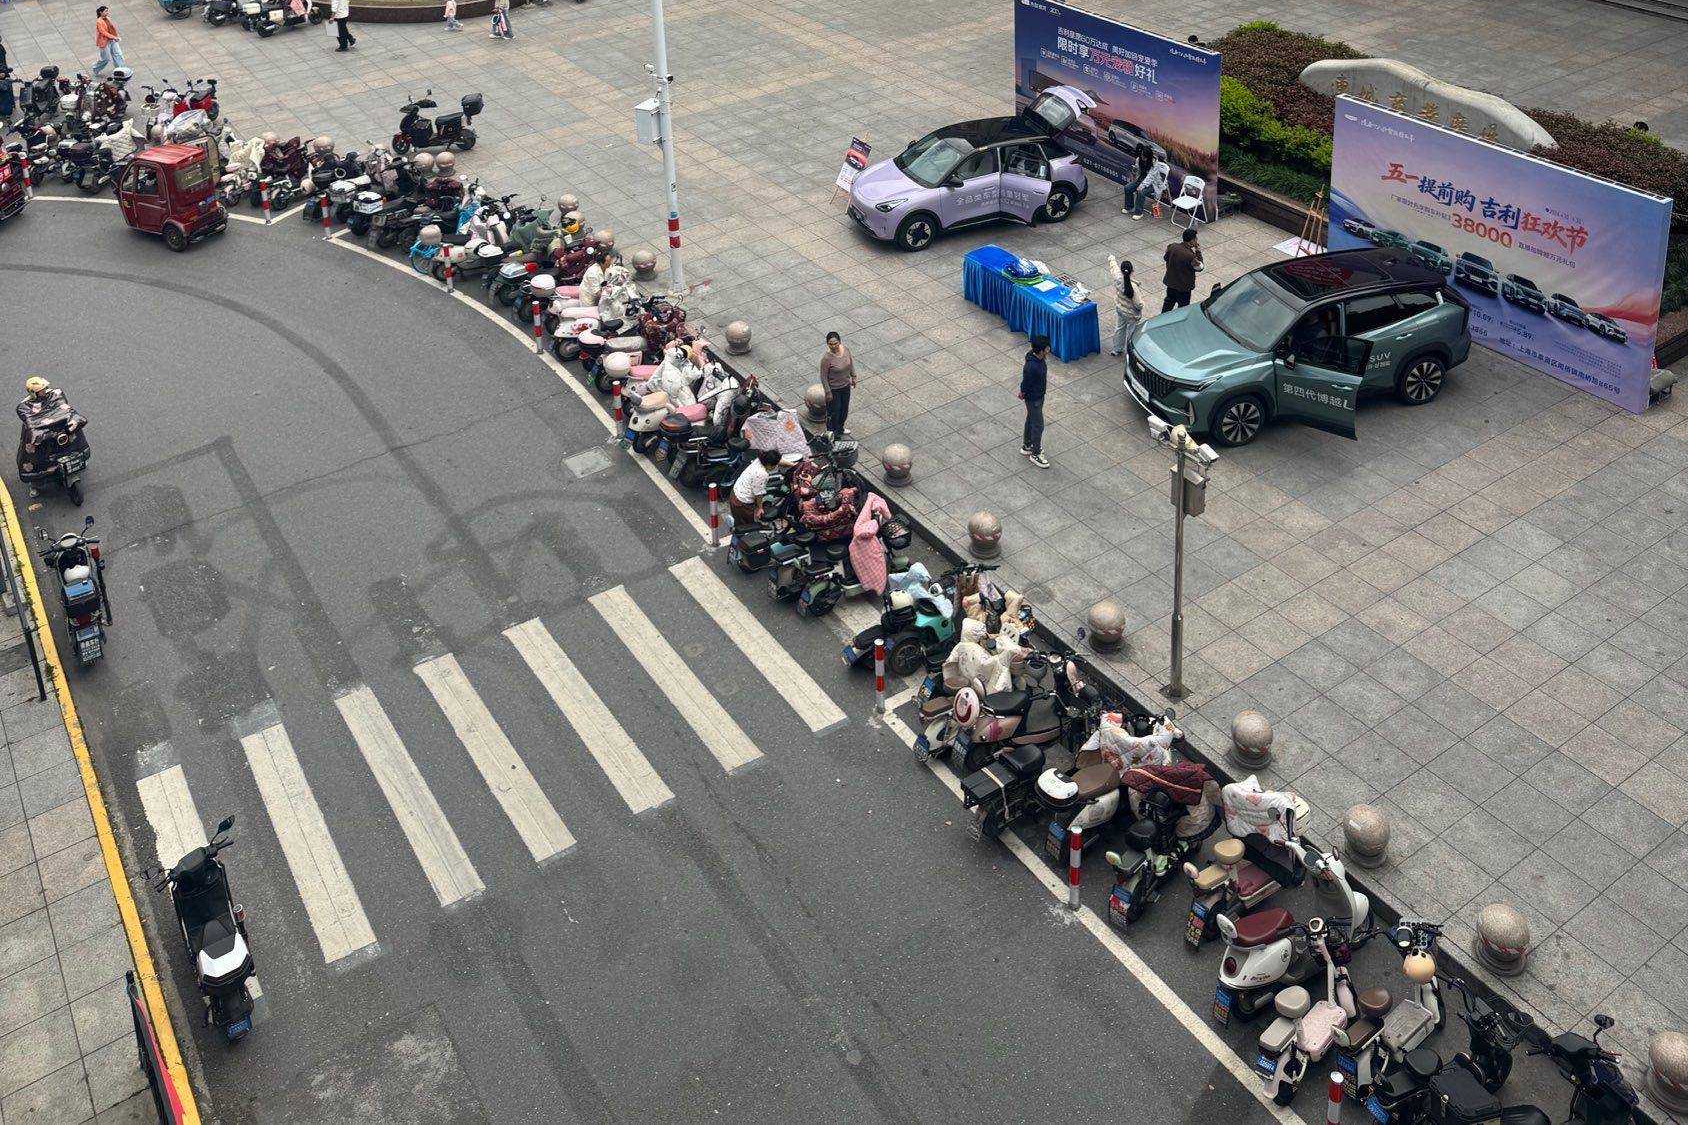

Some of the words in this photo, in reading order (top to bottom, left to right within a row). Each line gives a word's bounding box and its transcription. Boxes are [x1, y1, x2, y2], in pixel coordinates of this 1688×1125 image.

[1381, 162, 1476, 213] 五一提前购
[1479, 196, 1590, 257] 吉利狂欢节
[1451, 212, 1514, 250] 38000
[1369, 351, 1392, 364] SUV
[1282, 382, 1355, 412] 第四代博越L
